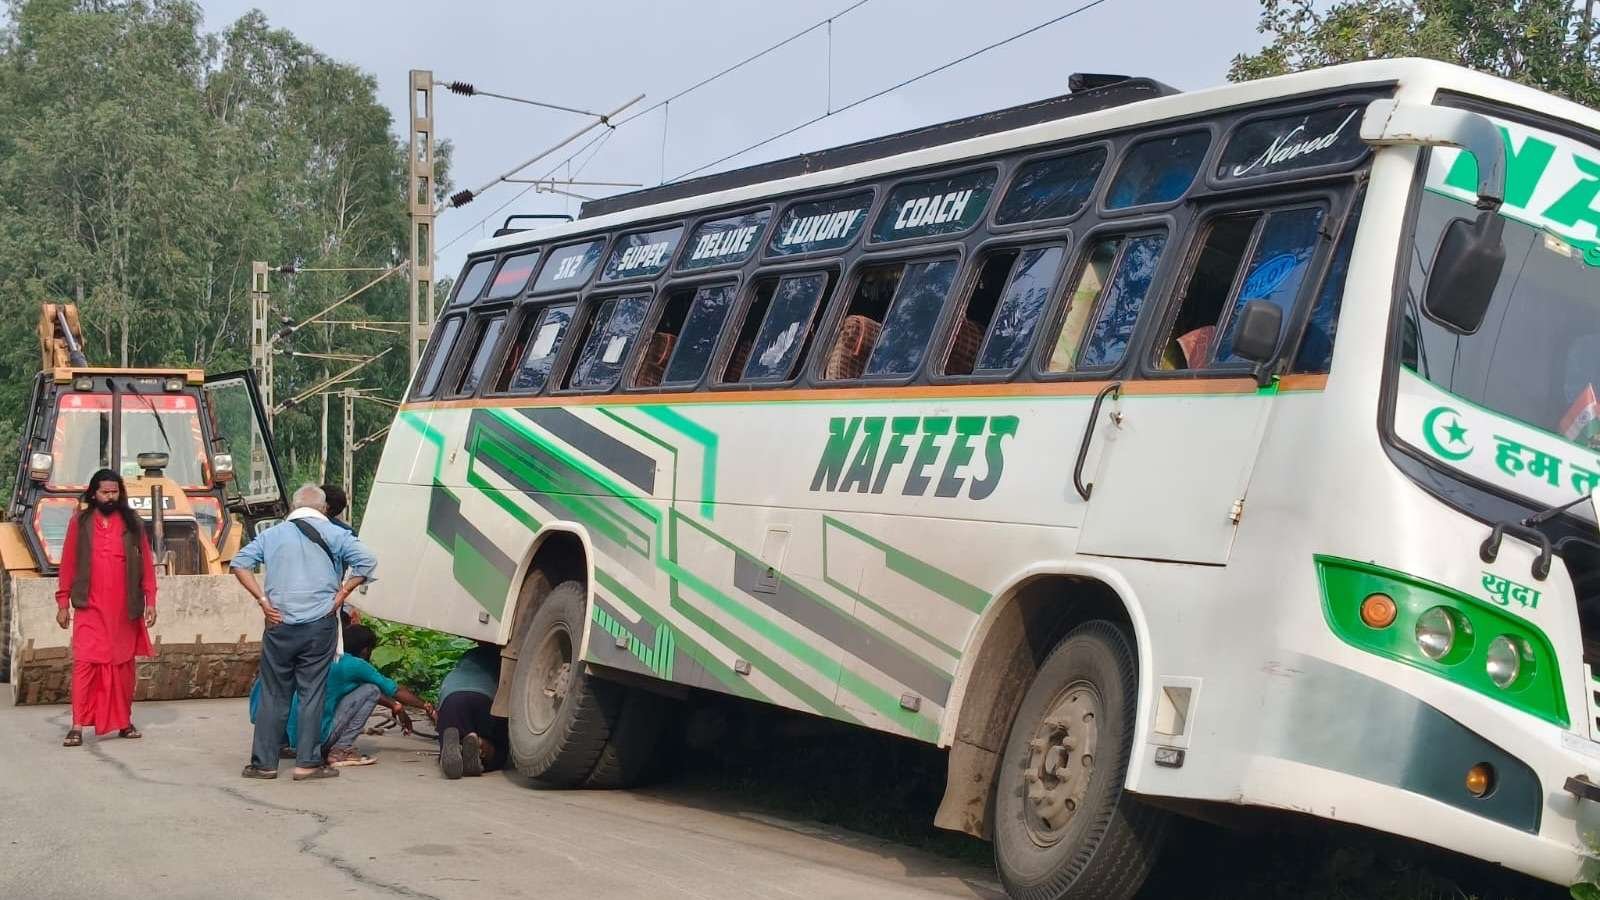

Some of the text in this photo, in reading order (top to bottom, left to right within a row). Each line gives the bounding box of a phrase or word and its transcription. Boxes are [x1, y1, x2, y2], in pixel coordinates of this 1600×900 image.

[1233, 108, 1358, 176] Naved
[617, 241, 669, 271] SUPER
[691, 225, 758, 260] DELUXE
[782, 208, 862, 246] LUXURY
[894, 189, 973, 230] COACH
[809, 415, 1020, 500] NAFEES
[1493, 434, 1562, 487] हम
[1481, 570, 1541, 609] खुदा
